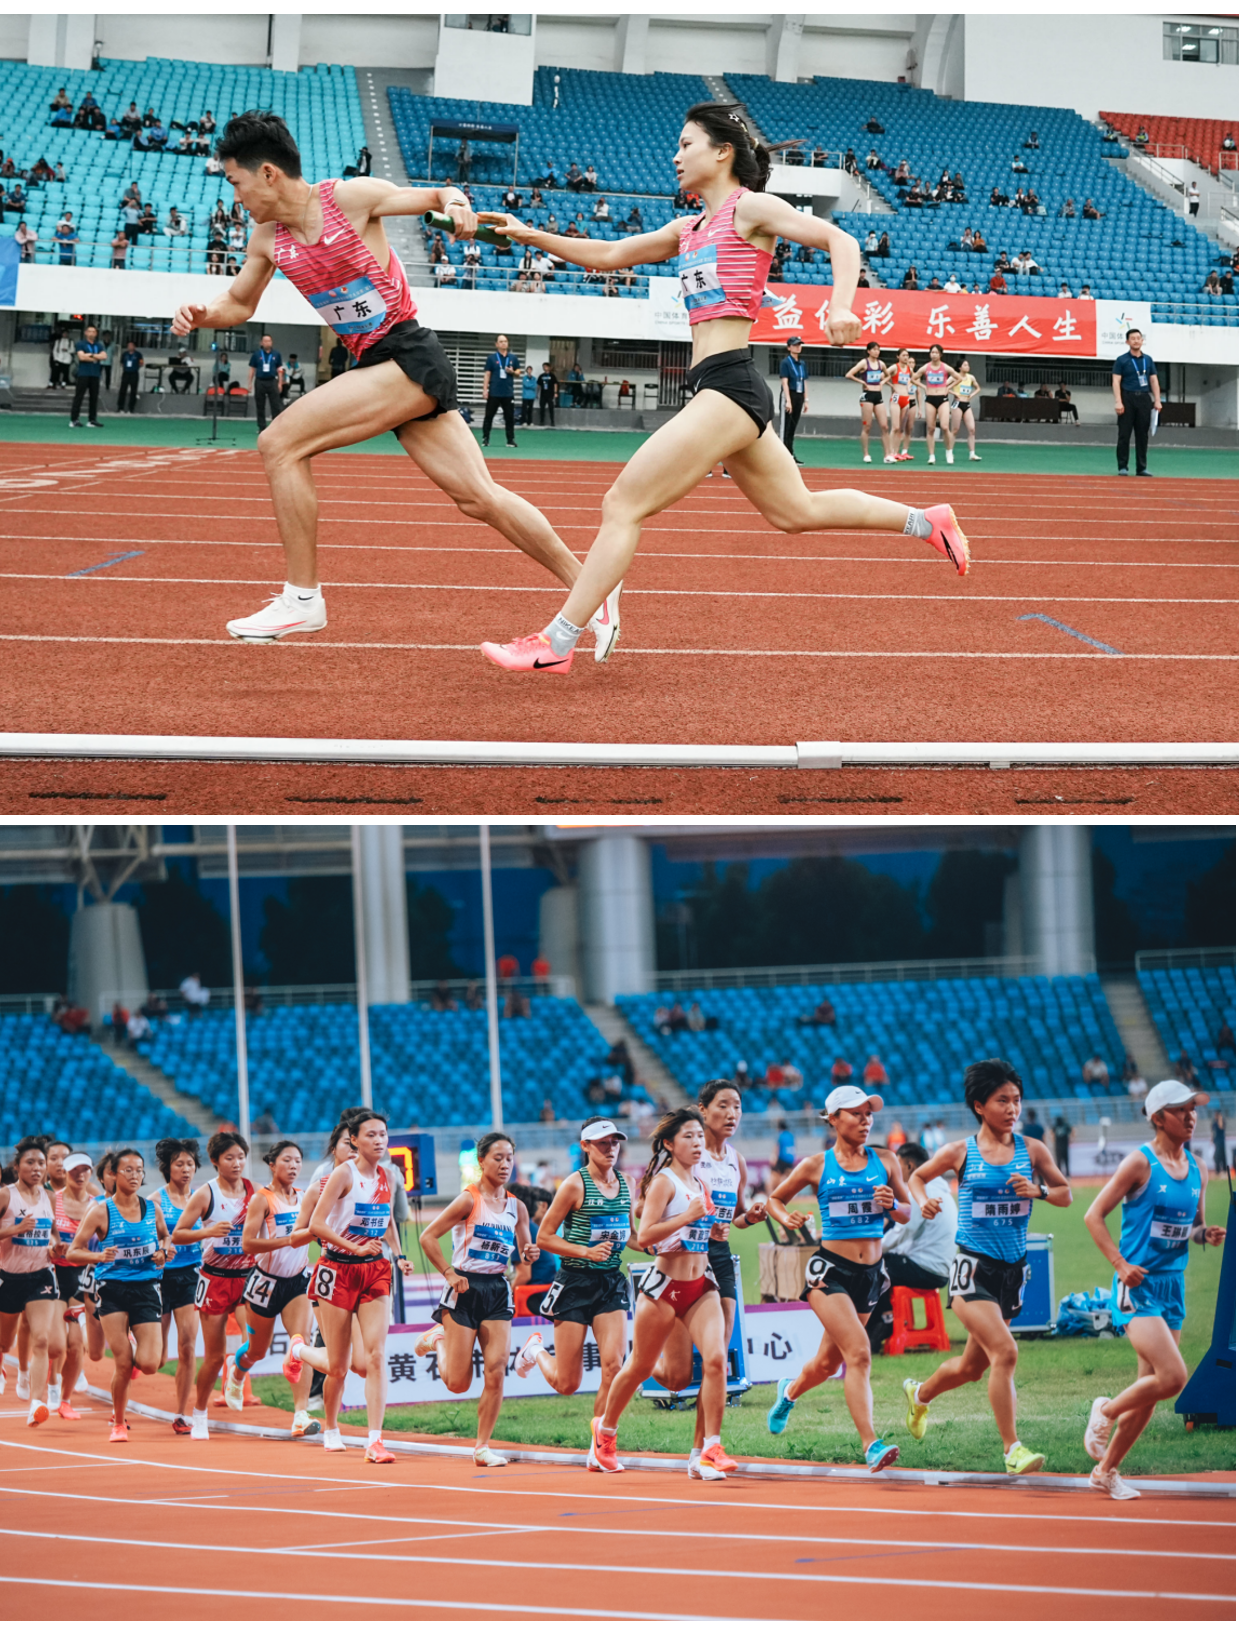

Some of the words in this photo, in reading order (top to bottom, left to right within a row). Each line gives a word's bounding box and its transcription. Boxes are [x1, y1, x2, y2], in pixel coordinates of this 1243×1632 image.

[681, 270, 707, 292] 广东
[333, 300, 372, 320] 广东
[927, 304, 1082, 342] 乐善人生
[847, 1201, 873, 1214] 周霞
[850, 1216, 870, 1224] 682
[993, 1218, 1013, 1226] 675
[223, 1237, 243, 1247] 马芳
[317, 1268, 334, 1297] 8
[951, 1258, 972, 1291] 20
[246, 1275, 271, 1304] 14
[541, 1283, 561, 1313] 5
